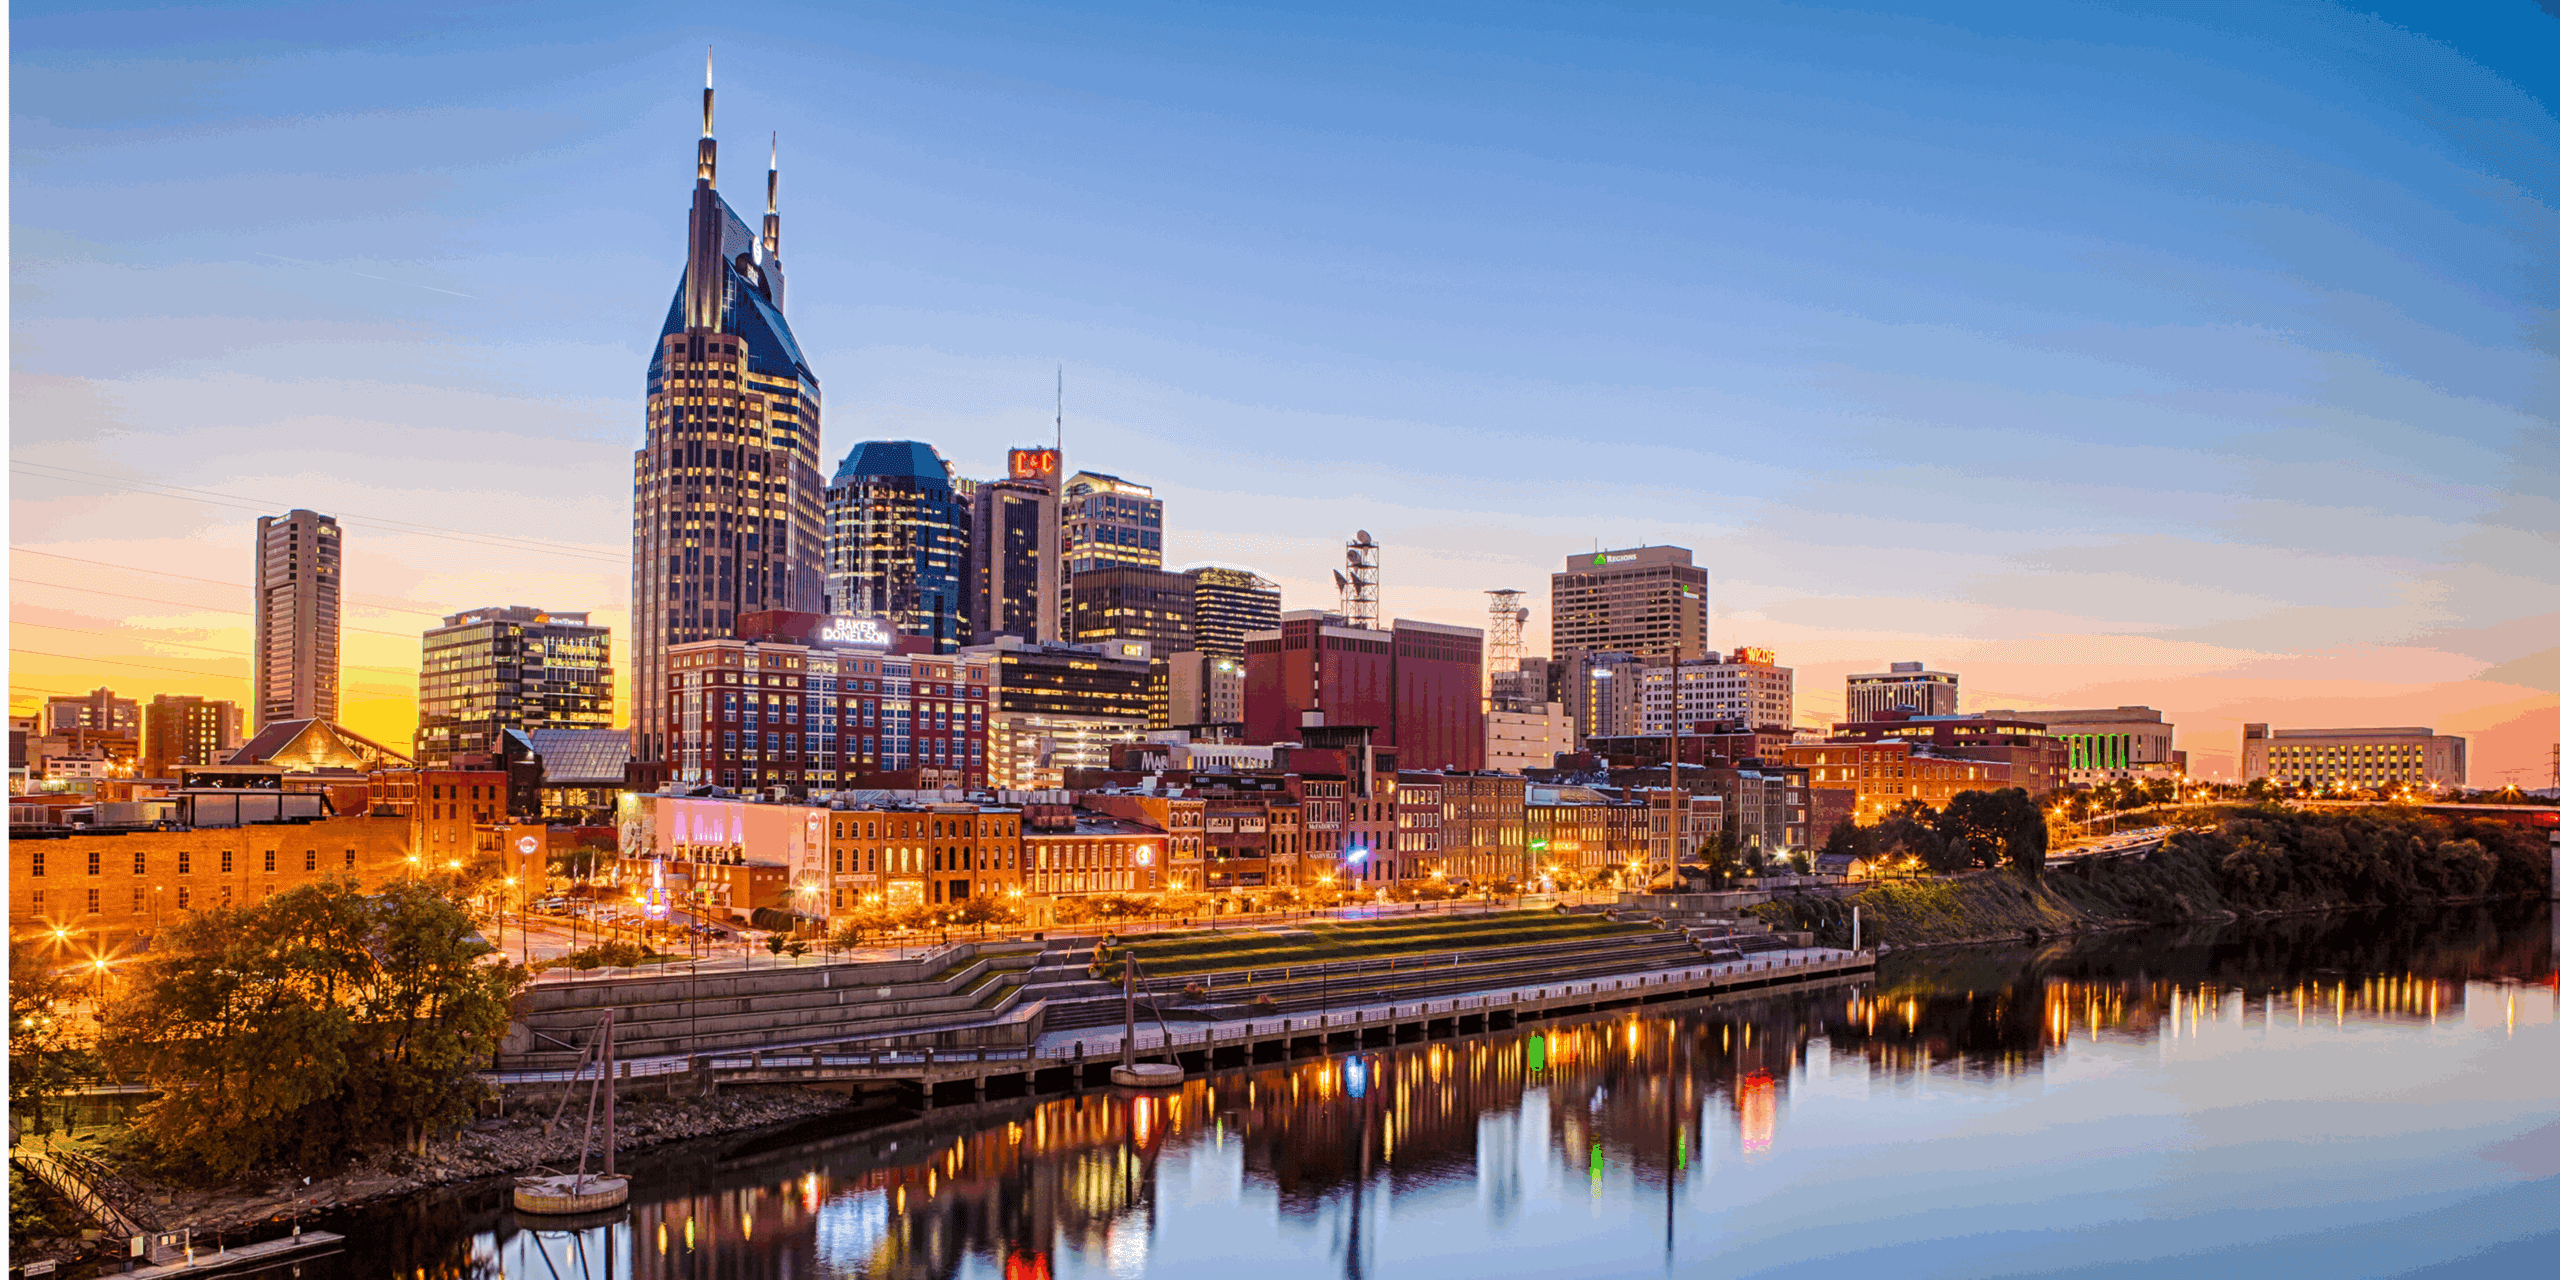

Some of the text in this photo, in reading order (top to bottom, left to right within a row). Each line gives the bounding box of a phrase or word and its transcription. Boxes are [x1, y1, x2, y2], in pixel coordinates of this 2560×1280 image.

[1606, 553, 1637, 563] REGIONS
[835, 618, 877, 633] BAKER
[822, 627, 891, 646] DONELSON
[1123, 643, 1143, 657] CMT
[1309, 851, 1338, 859] NASHVILLE
